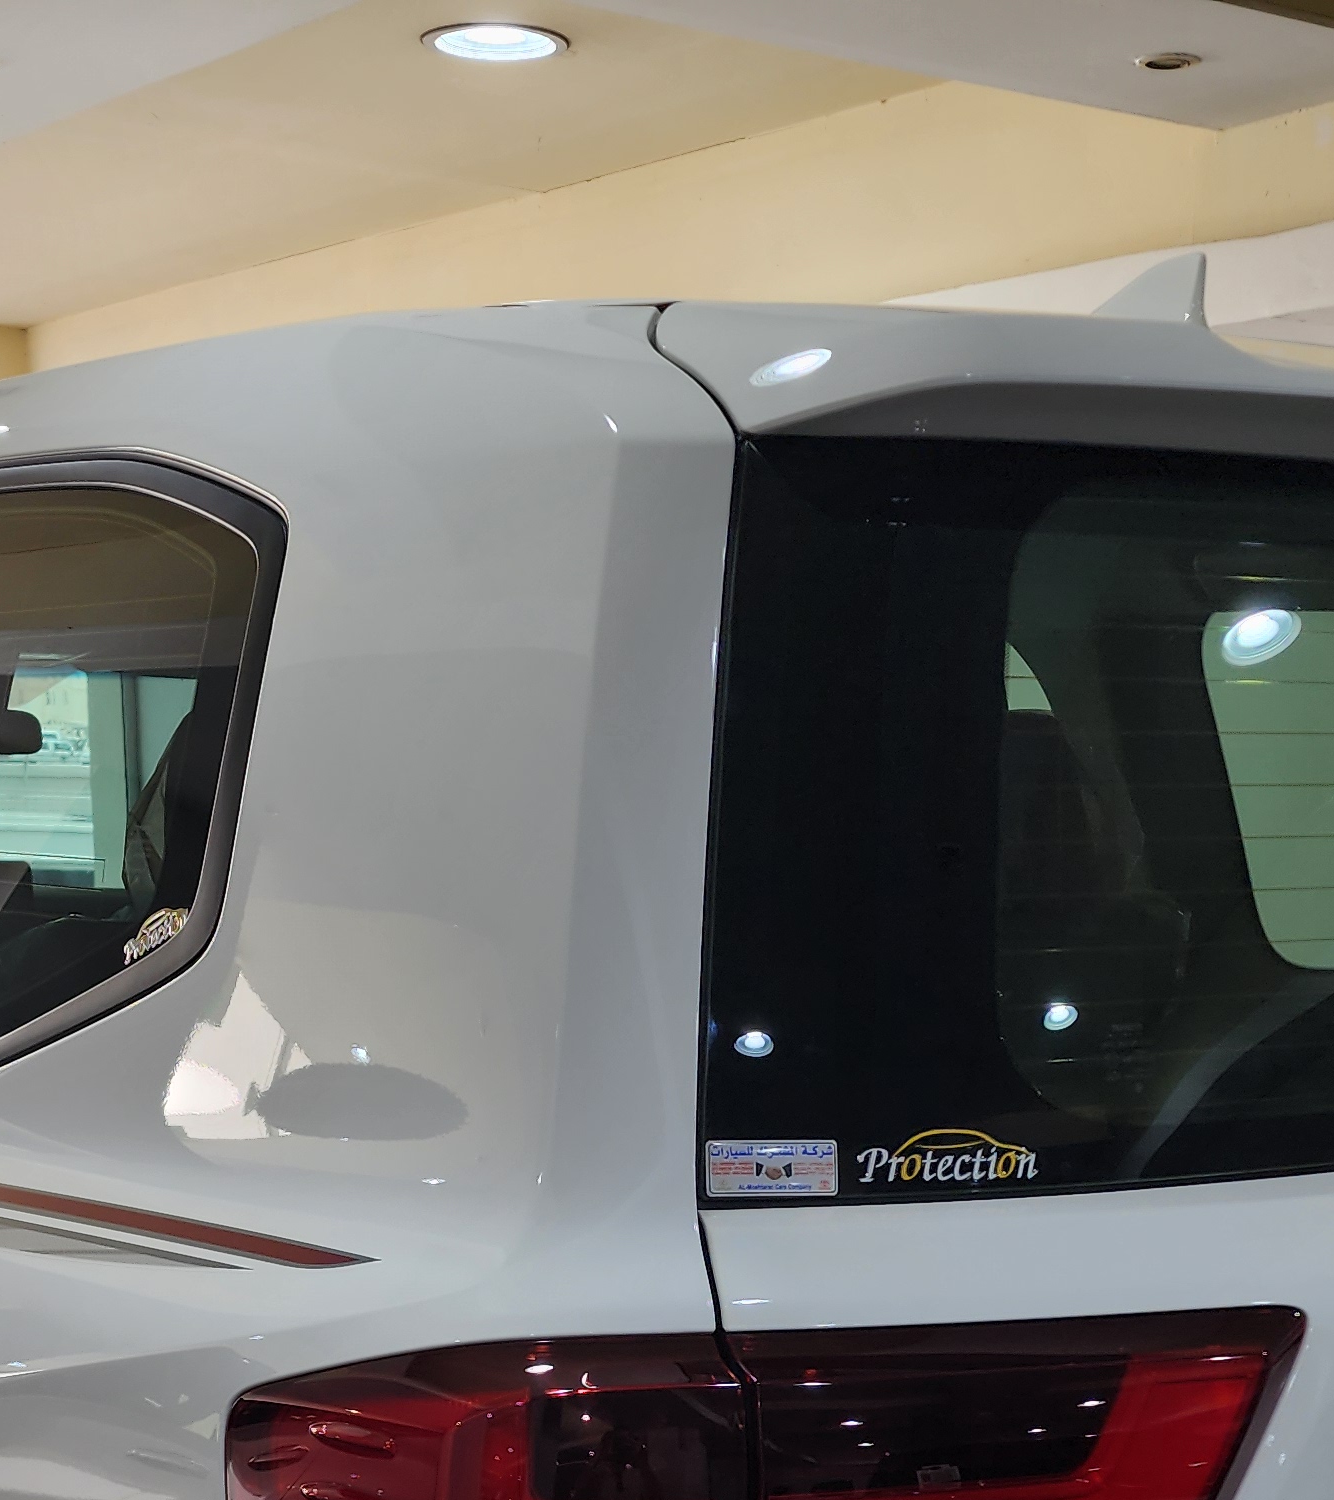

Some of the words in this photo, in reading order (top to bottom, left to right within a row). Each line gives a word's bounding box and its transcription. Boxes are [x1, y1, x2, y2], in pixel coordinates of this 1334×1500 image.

[710, 1145, 754, 1160] للسيارات
[802, 1145, 834, 1159] شركة
[855, 1145, 1039, 1184] Protection
